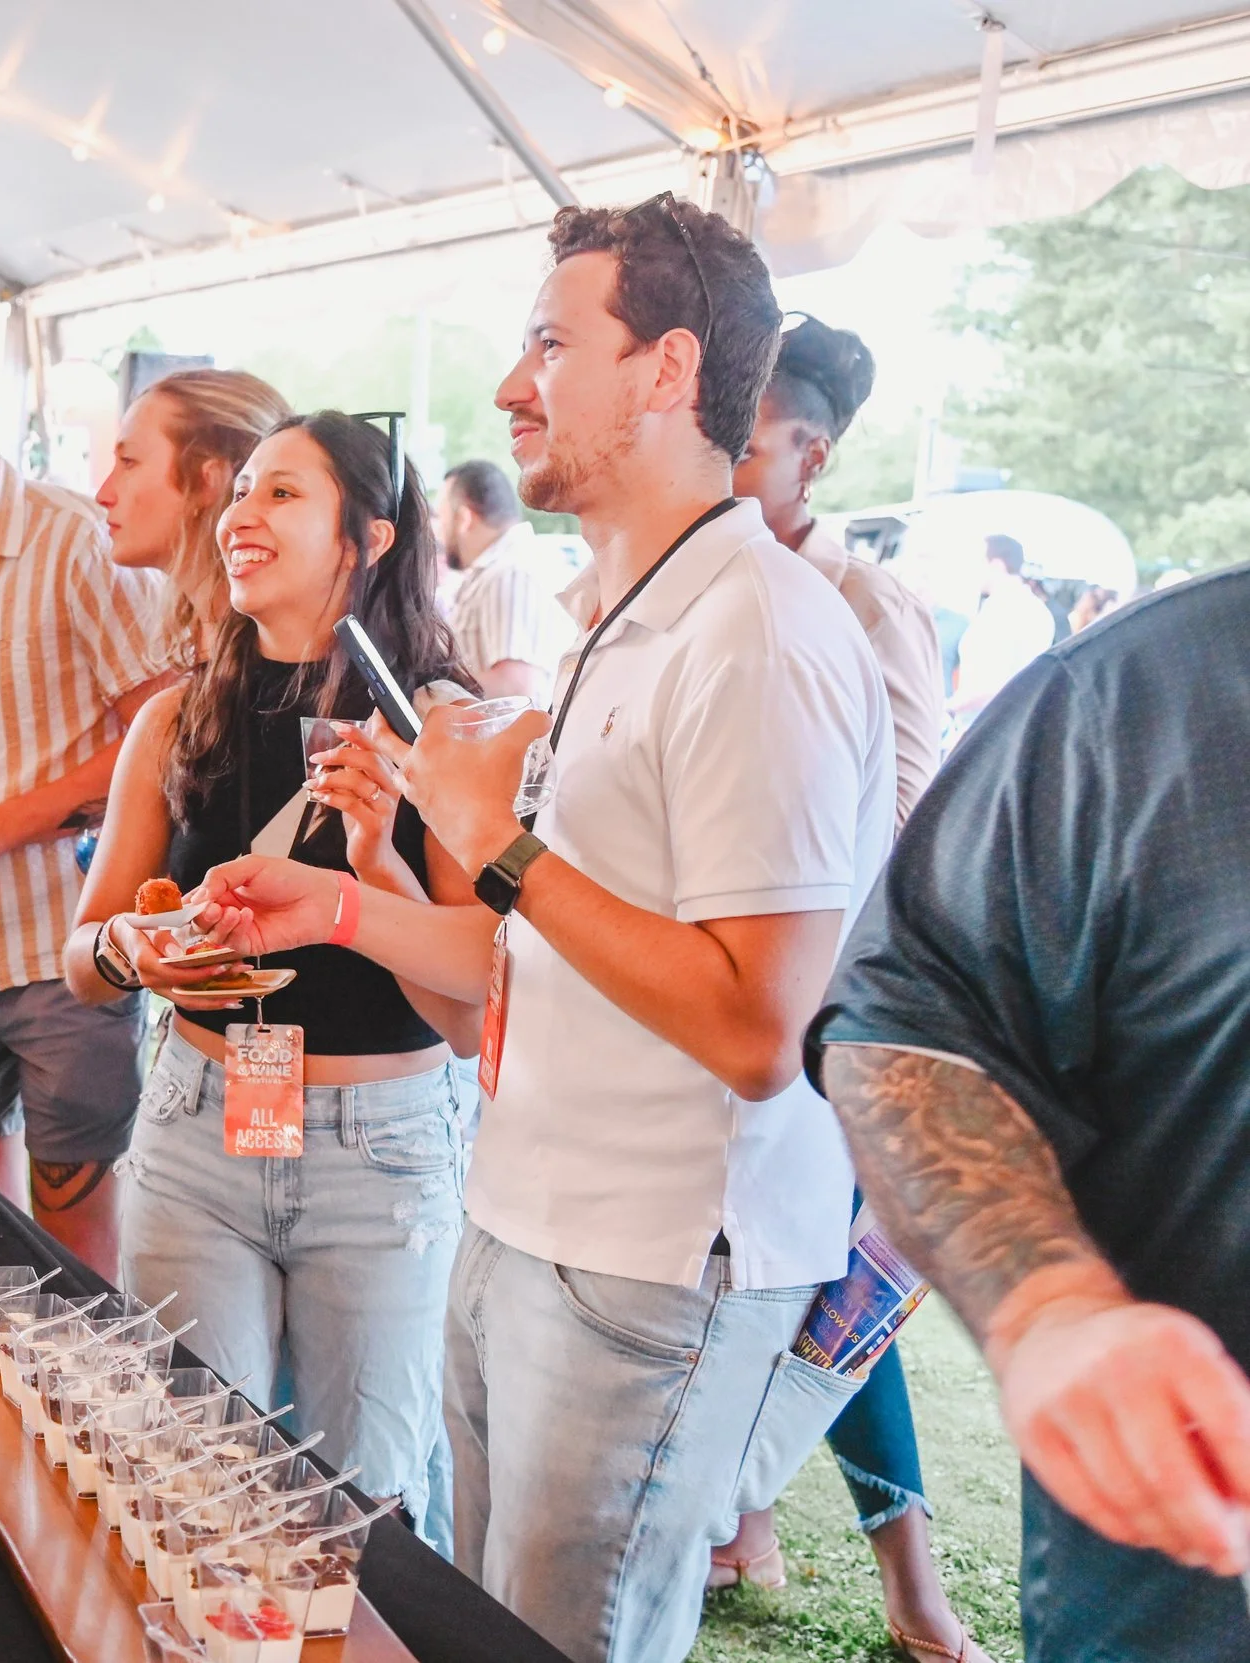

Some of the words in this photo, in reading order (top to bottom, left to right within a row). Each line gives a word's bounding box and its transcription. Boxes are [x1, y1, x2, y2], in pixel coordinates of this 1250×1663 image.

[237, 1048, 293, 1064] FOOD
[236, 1064, 249, 1076] &
[250, 1064, 293, 1077] WINE
[250, 1107, 278, 1127] ALL
[818, 1296, 847, 1328] OLLOW
[846, 1328, 861, 1344] US
